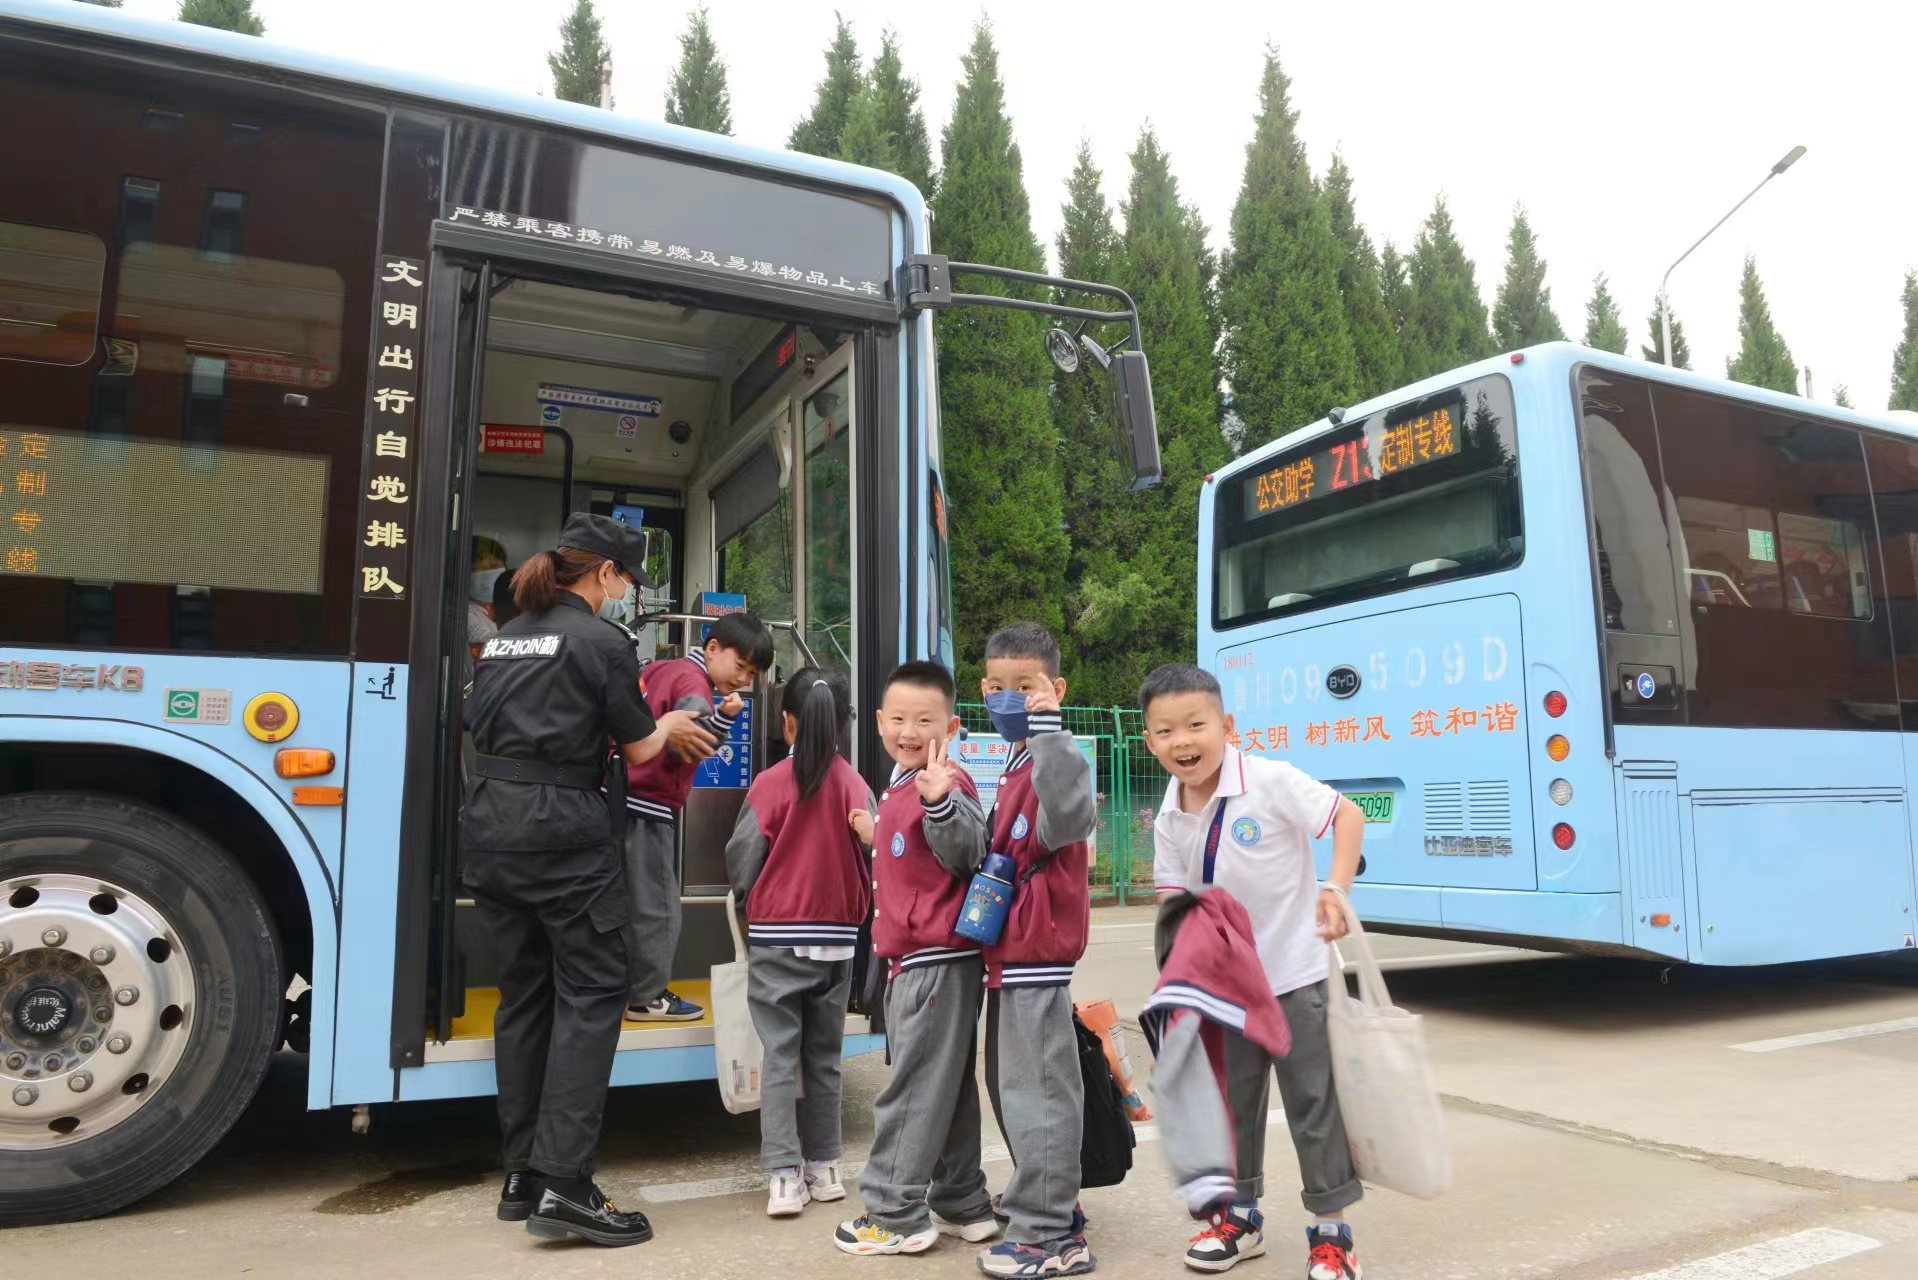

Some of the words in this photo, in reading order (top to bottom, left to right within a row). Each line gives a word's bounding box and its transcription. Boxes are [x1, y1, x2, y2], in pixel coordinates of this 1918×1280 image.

[449, 206, 881, 296] 严禁乘客携带易燃及易爆物品上车
[362, 260, 424, 594] 文明出行自觉排队
[1256, 456, 1315, 513] 公交助学
[1378, 408, 1454, 475] 定制专线
[6, 432, 51, 575] 定制专线
[1329, 674, 1356, 690] BYD
[1305, 715, 1392, 747] 树新风
[1410, 701, 1519, 738] 筑和谐
[740, 745, 749, 787] 自动售票
[987, 743, 1008, 754] 坚决
[1424, 835, 1513, 857] 比亚迪客车
[35, 1007, 67, 1033] Maint
